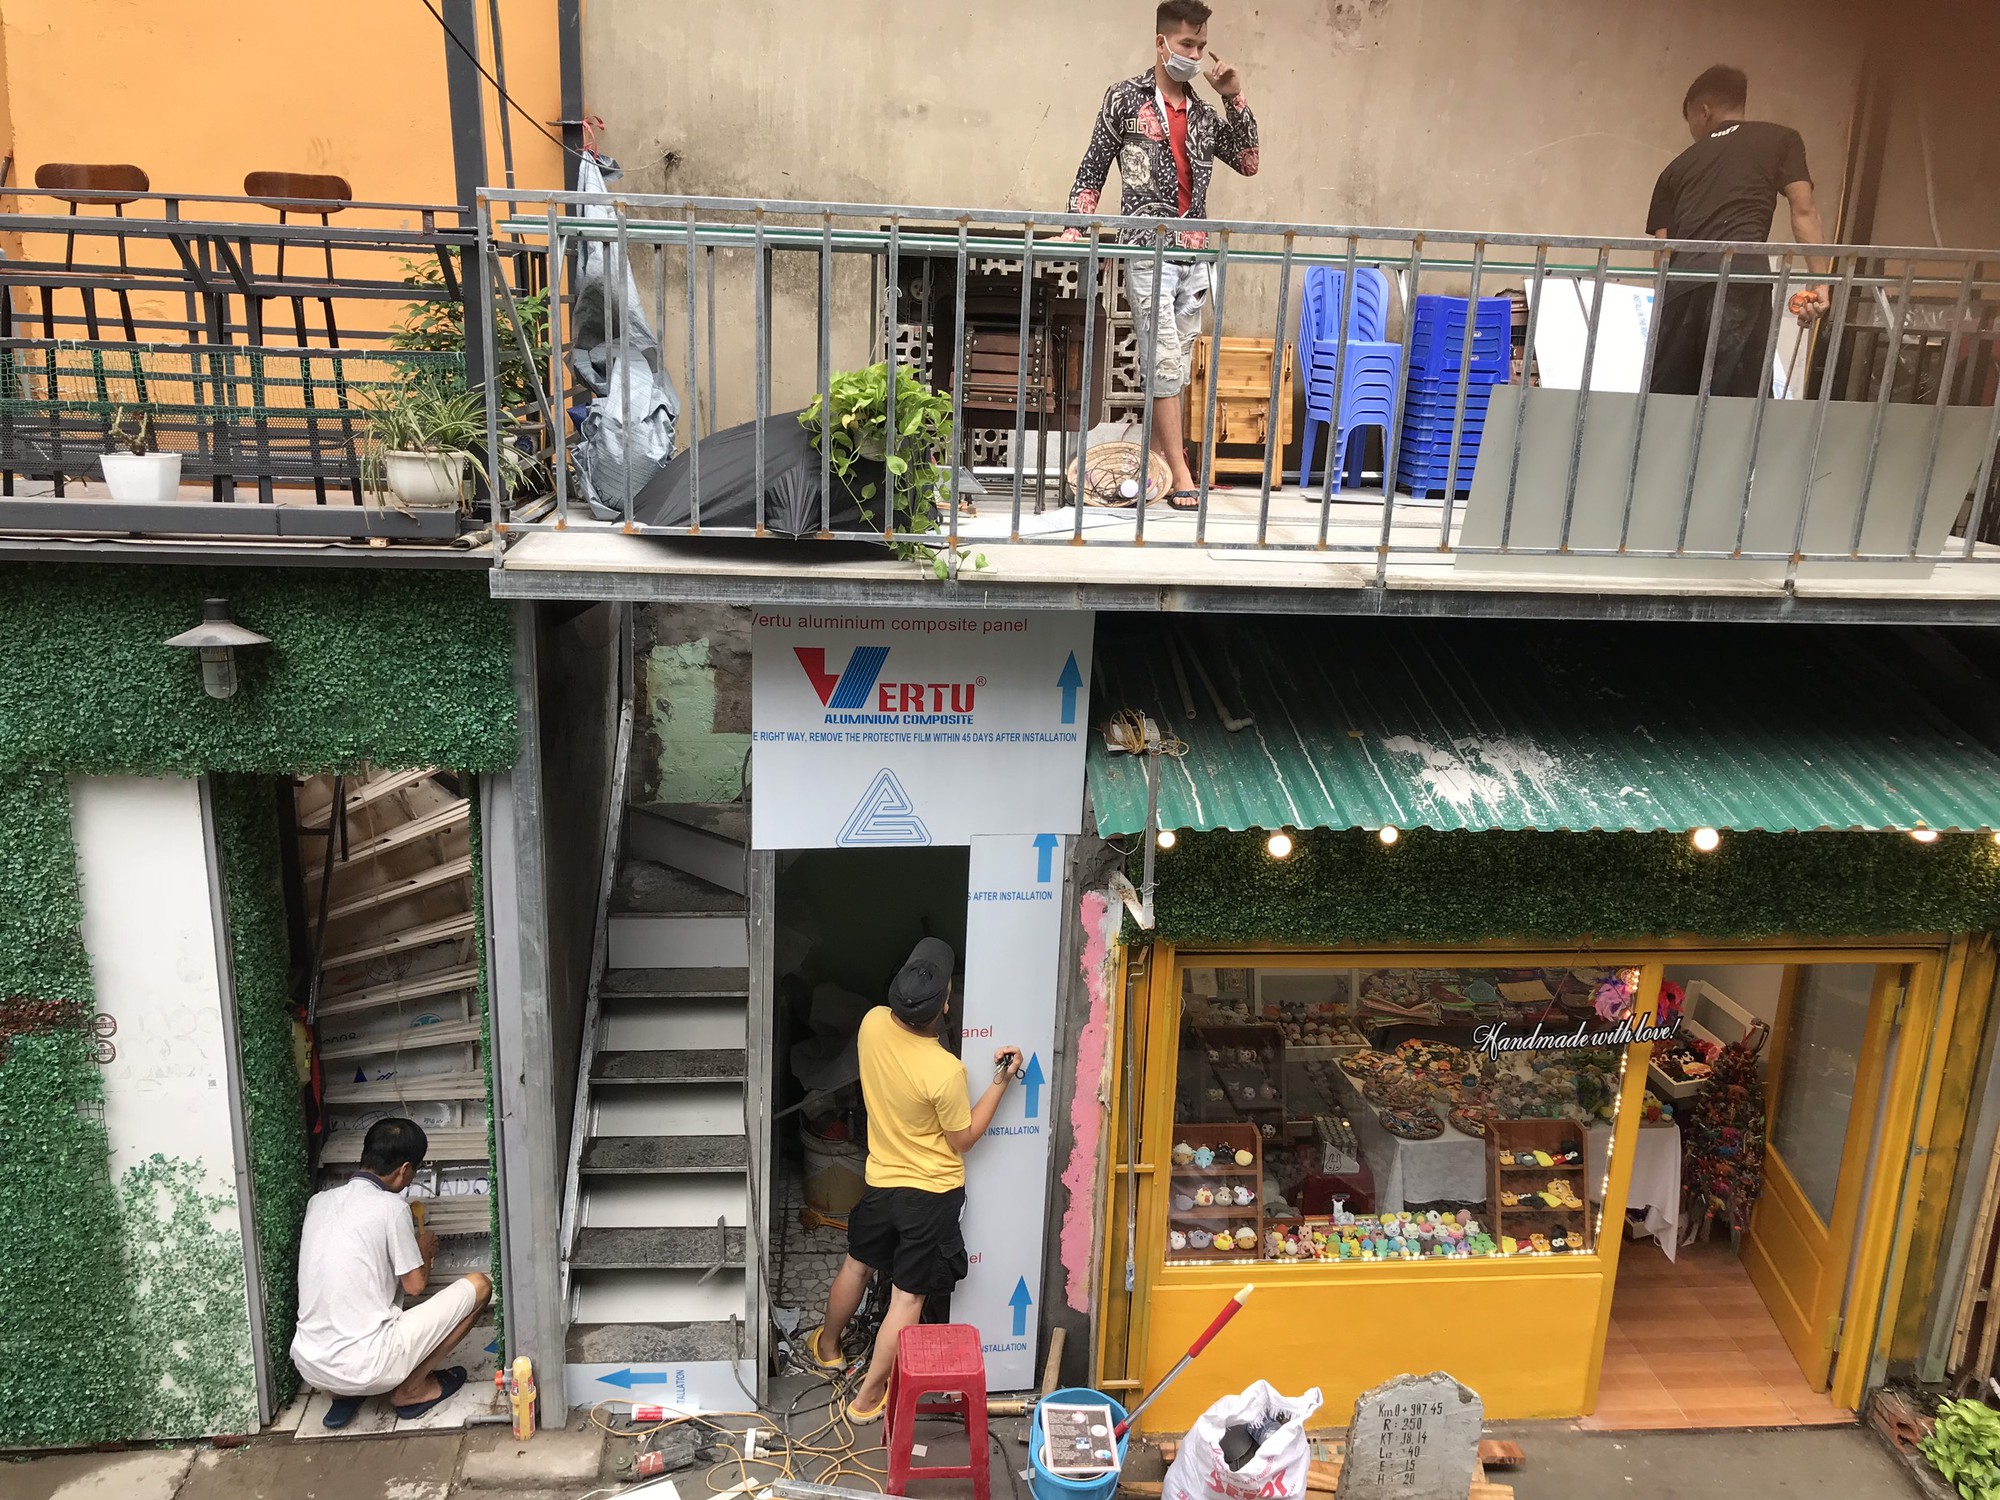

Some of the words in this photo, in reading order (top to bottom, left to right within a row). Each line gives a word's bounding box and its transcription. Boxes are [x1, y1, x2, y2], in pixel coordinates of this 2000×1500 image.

[798, 614, 885, 630] aluminium
[891, 617, 977, 634] composite
[983, 617, 1028, 634] panel
[824, 714, 899, 725] ALUMINIUM
[903, 714, 974, 725] COMPOSITE
[760, 732, 785, 742] RIGHT
[810, 732, 843, 742] REMOVE
[845, 732, 858, 742] THE
[863, 732, 911, 742] PROTECTIVE
[913, 732, 931, 742] FILM
[933, 732, 960, 742] WITHIN
[962, 732, 971, 742] 45
[974, 732, 994, 742] DAYS
[995, 732, 1020, 742] AFTER
[1022, 732, 1077, 742] INSTALLATION
[973, 891, 998, 900] AFTER
[1000, 891, 1052, 900] INSTALLATION
[1473, 1021, 1592, 1061] Handmade
[1591, 1013, 1634, 1046] with
[1634, 1011, 1682, 1044] love!
[988, 1126, 1040, 1136] INSTALLATION
[1401, 1417, 1422, 1430] 250
[1408, 1446, 1420, 1458] 40
[1405, 1460, 1415, 1472] 15
[1403, 1473, 1415, 1485] 20
